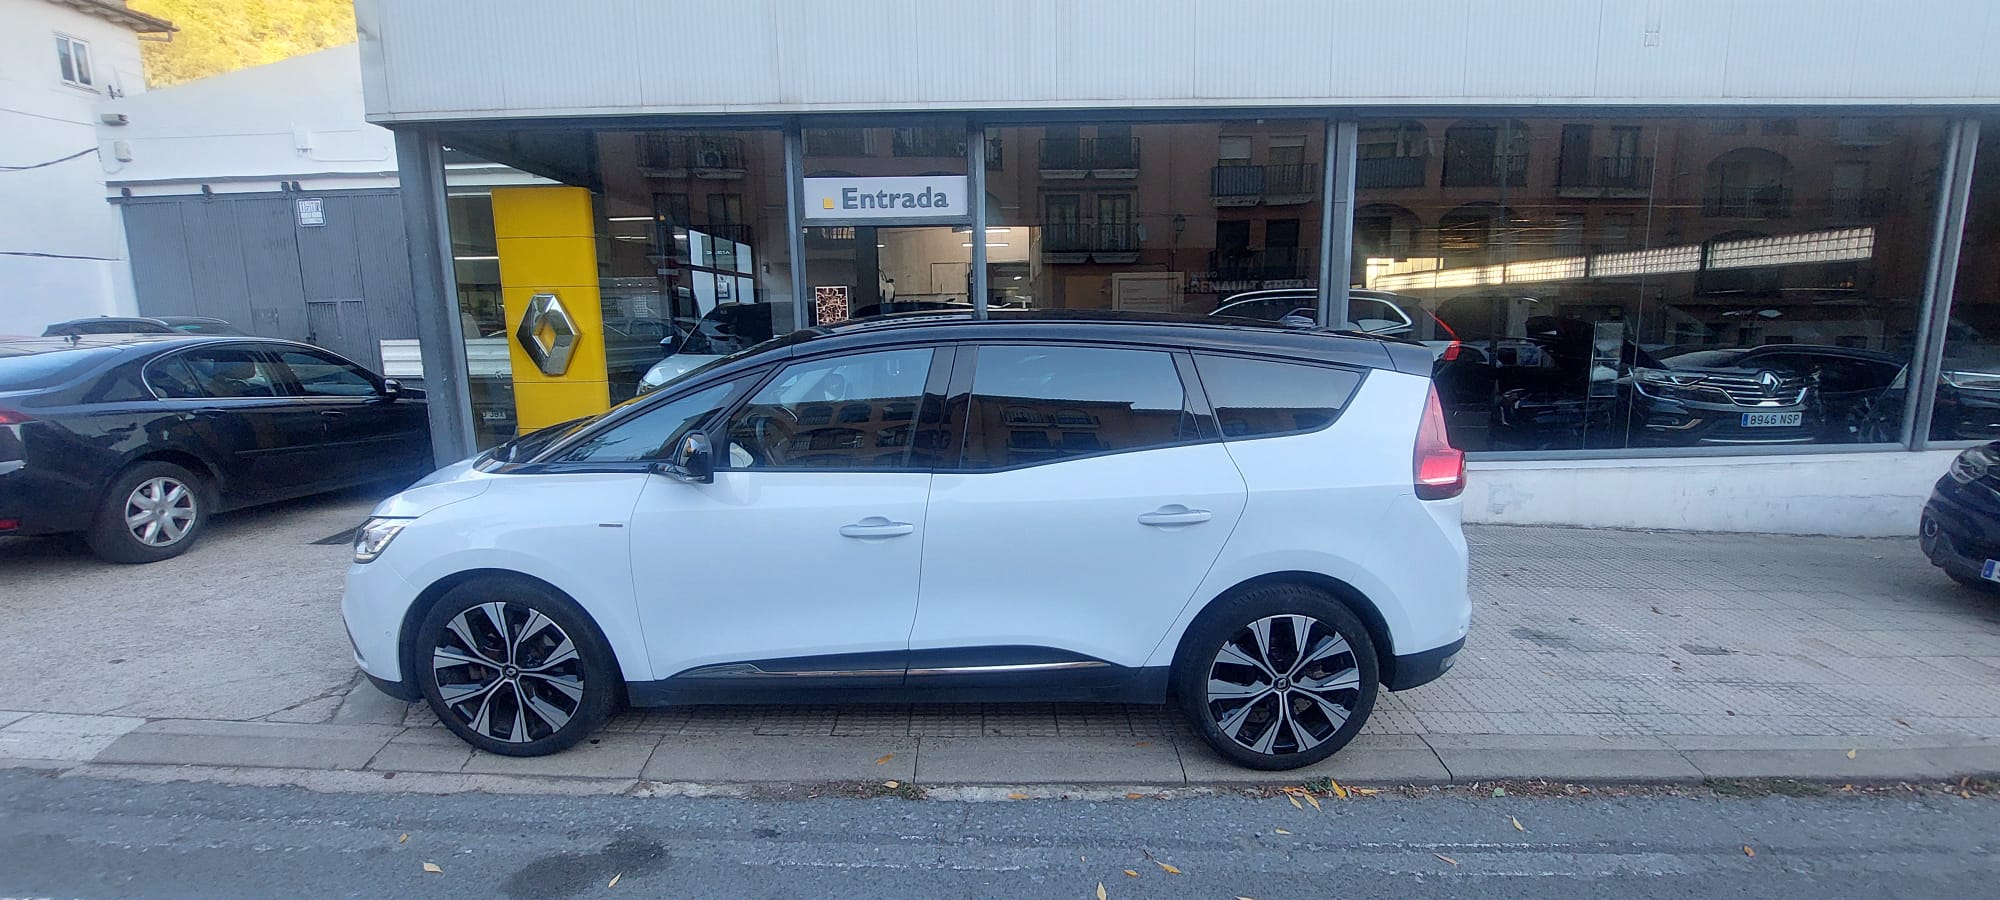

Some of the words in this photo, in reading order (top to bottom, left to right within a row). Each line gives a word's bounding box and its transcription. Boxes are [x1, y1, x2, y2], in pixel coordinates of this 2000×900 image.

[842, 186, 949, 210] Entrada
[1190, 280, 1260, 293] RENAULT
[1750, 415, 1777, 425] 8946
[1780, 414, 1800, 425] NSP
